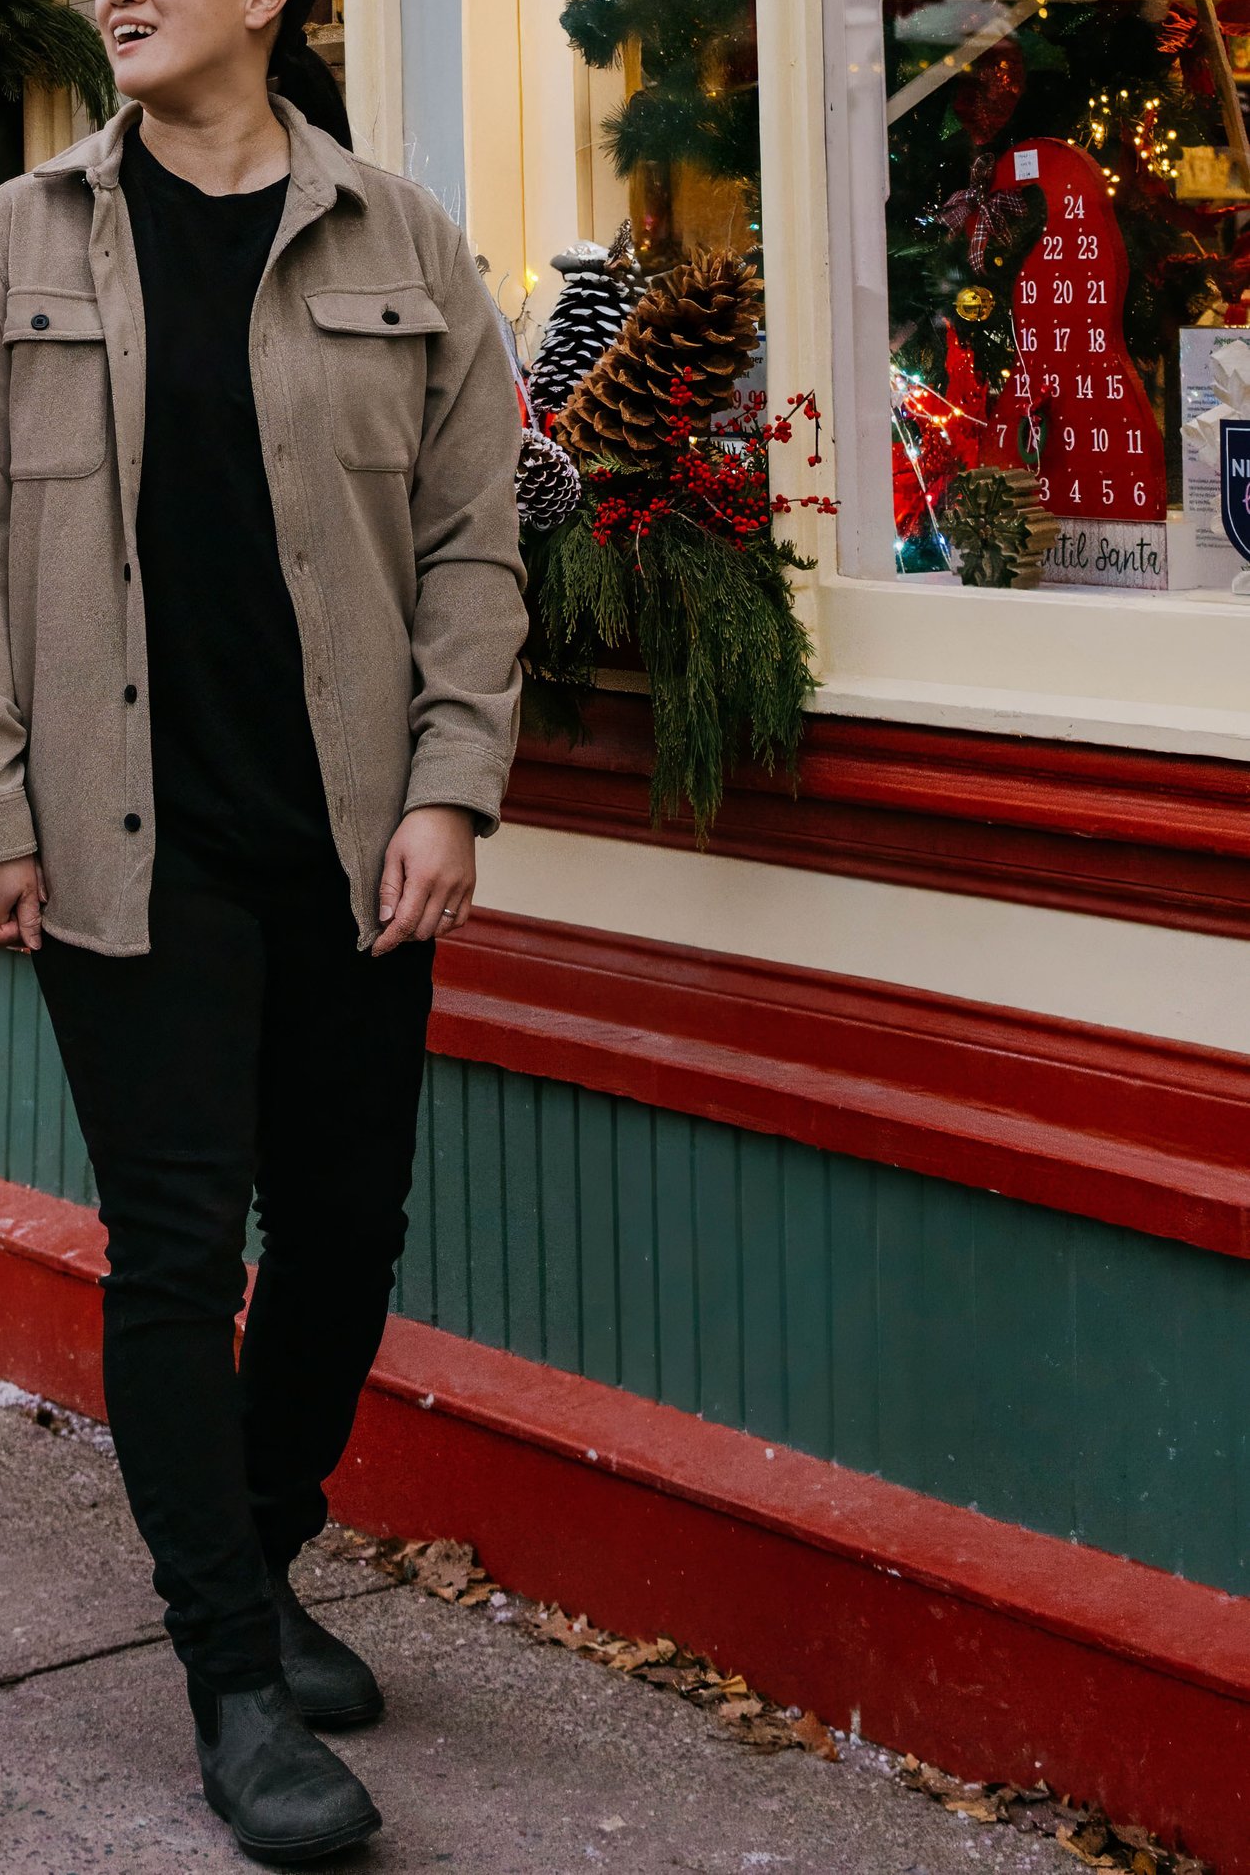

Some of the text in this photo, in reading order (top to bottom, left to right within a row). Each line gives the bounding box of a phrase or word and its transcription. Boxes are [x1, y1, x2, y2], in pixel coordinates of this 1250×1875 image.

[1064, 195, 1084, 219] 24
[1043, 236, 1098, 259] 22 23
[1021, 280, 1107, 304] 19 20 21
[1020, 328, 1105, 352] 16 17 18
[1014, 374, 1030, 397] 12
[1076, 375, 1093, 398] 14
[1106, 375, 1123, 399] 15
[997, 425, 1007, 448] 7
[1064, 427, 1074, 450] 9
[1091, 428, 1108, 452] 10
[1127, 430, 1143, 453] 11
[1039, 477, 1145, 505] 3 4 5 6
[1041, 532, 1089, 568] ntil
[1095, 537, 1161, 574] Santa
